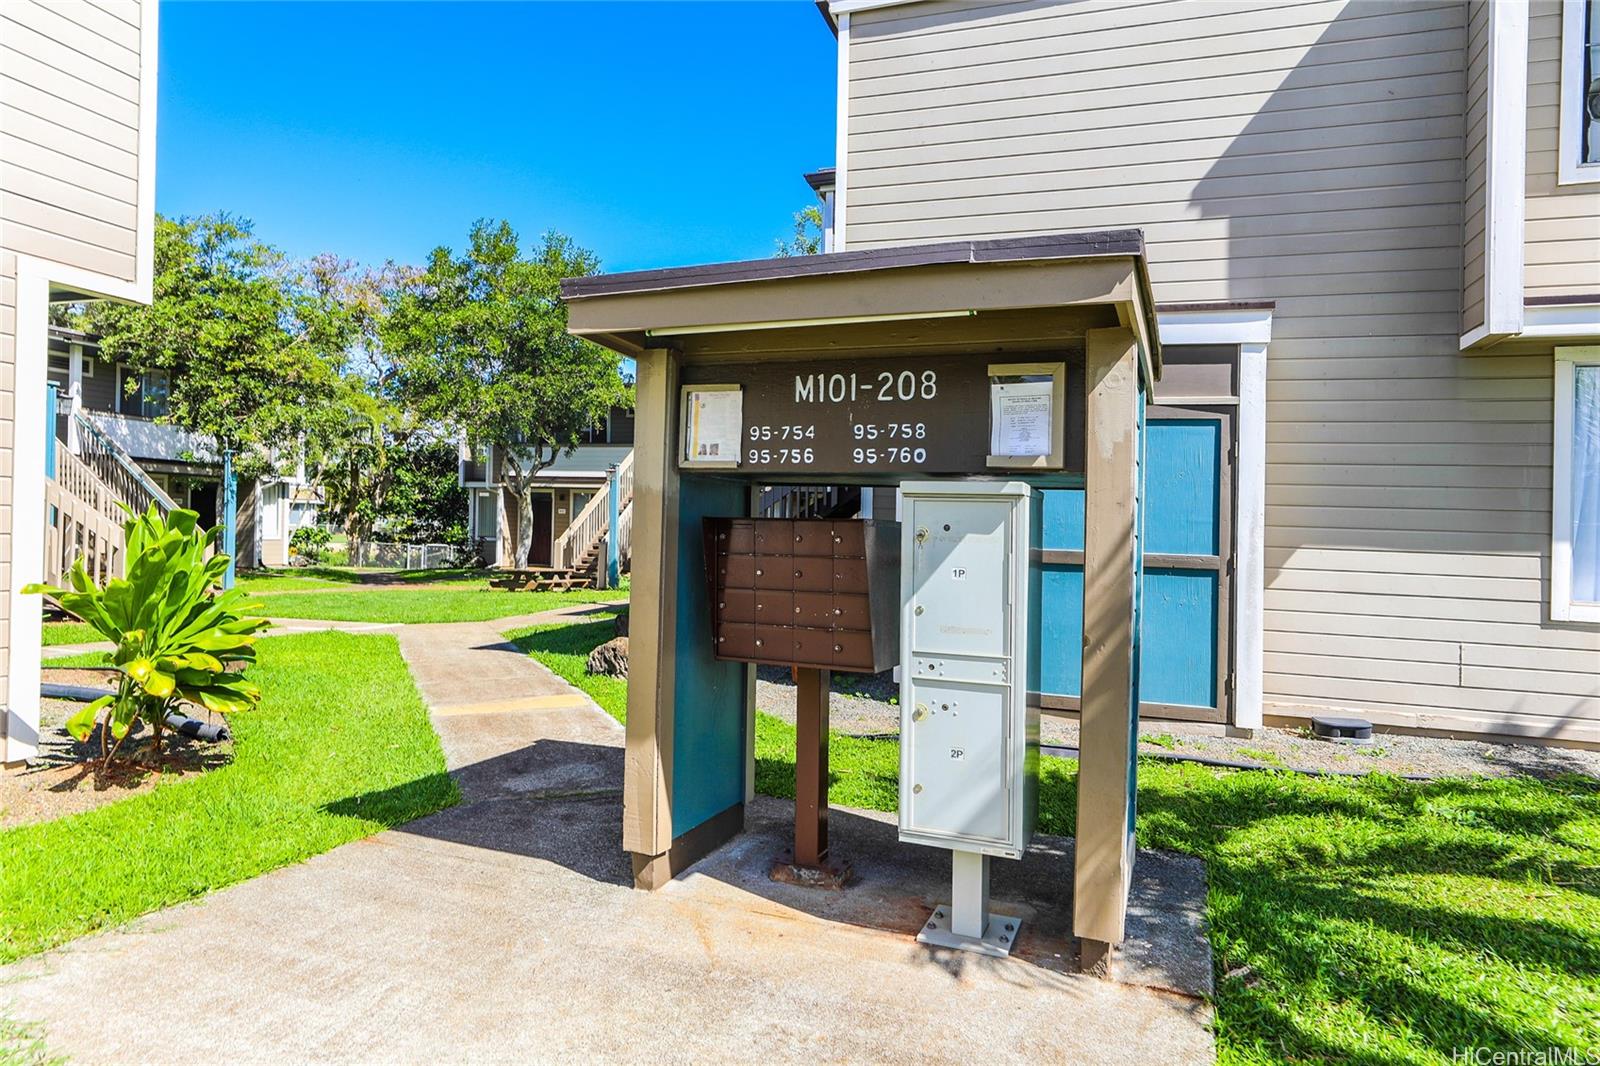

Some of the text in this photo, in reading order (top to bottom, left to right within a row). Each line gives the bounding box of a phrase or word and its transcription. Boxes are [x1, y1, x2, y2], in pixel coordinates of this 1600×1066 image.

[795, 370, 937, 402] M101-208
[750, 425, 815, 440] 95-754
[853, 423, 926, 439] 95-758
[749, 448, 814, 464] 95-756
[853, 448, 926, 464] 95-760
[952, 569, 966, 578] 1P
[950, 749, 964, 759] 2P
